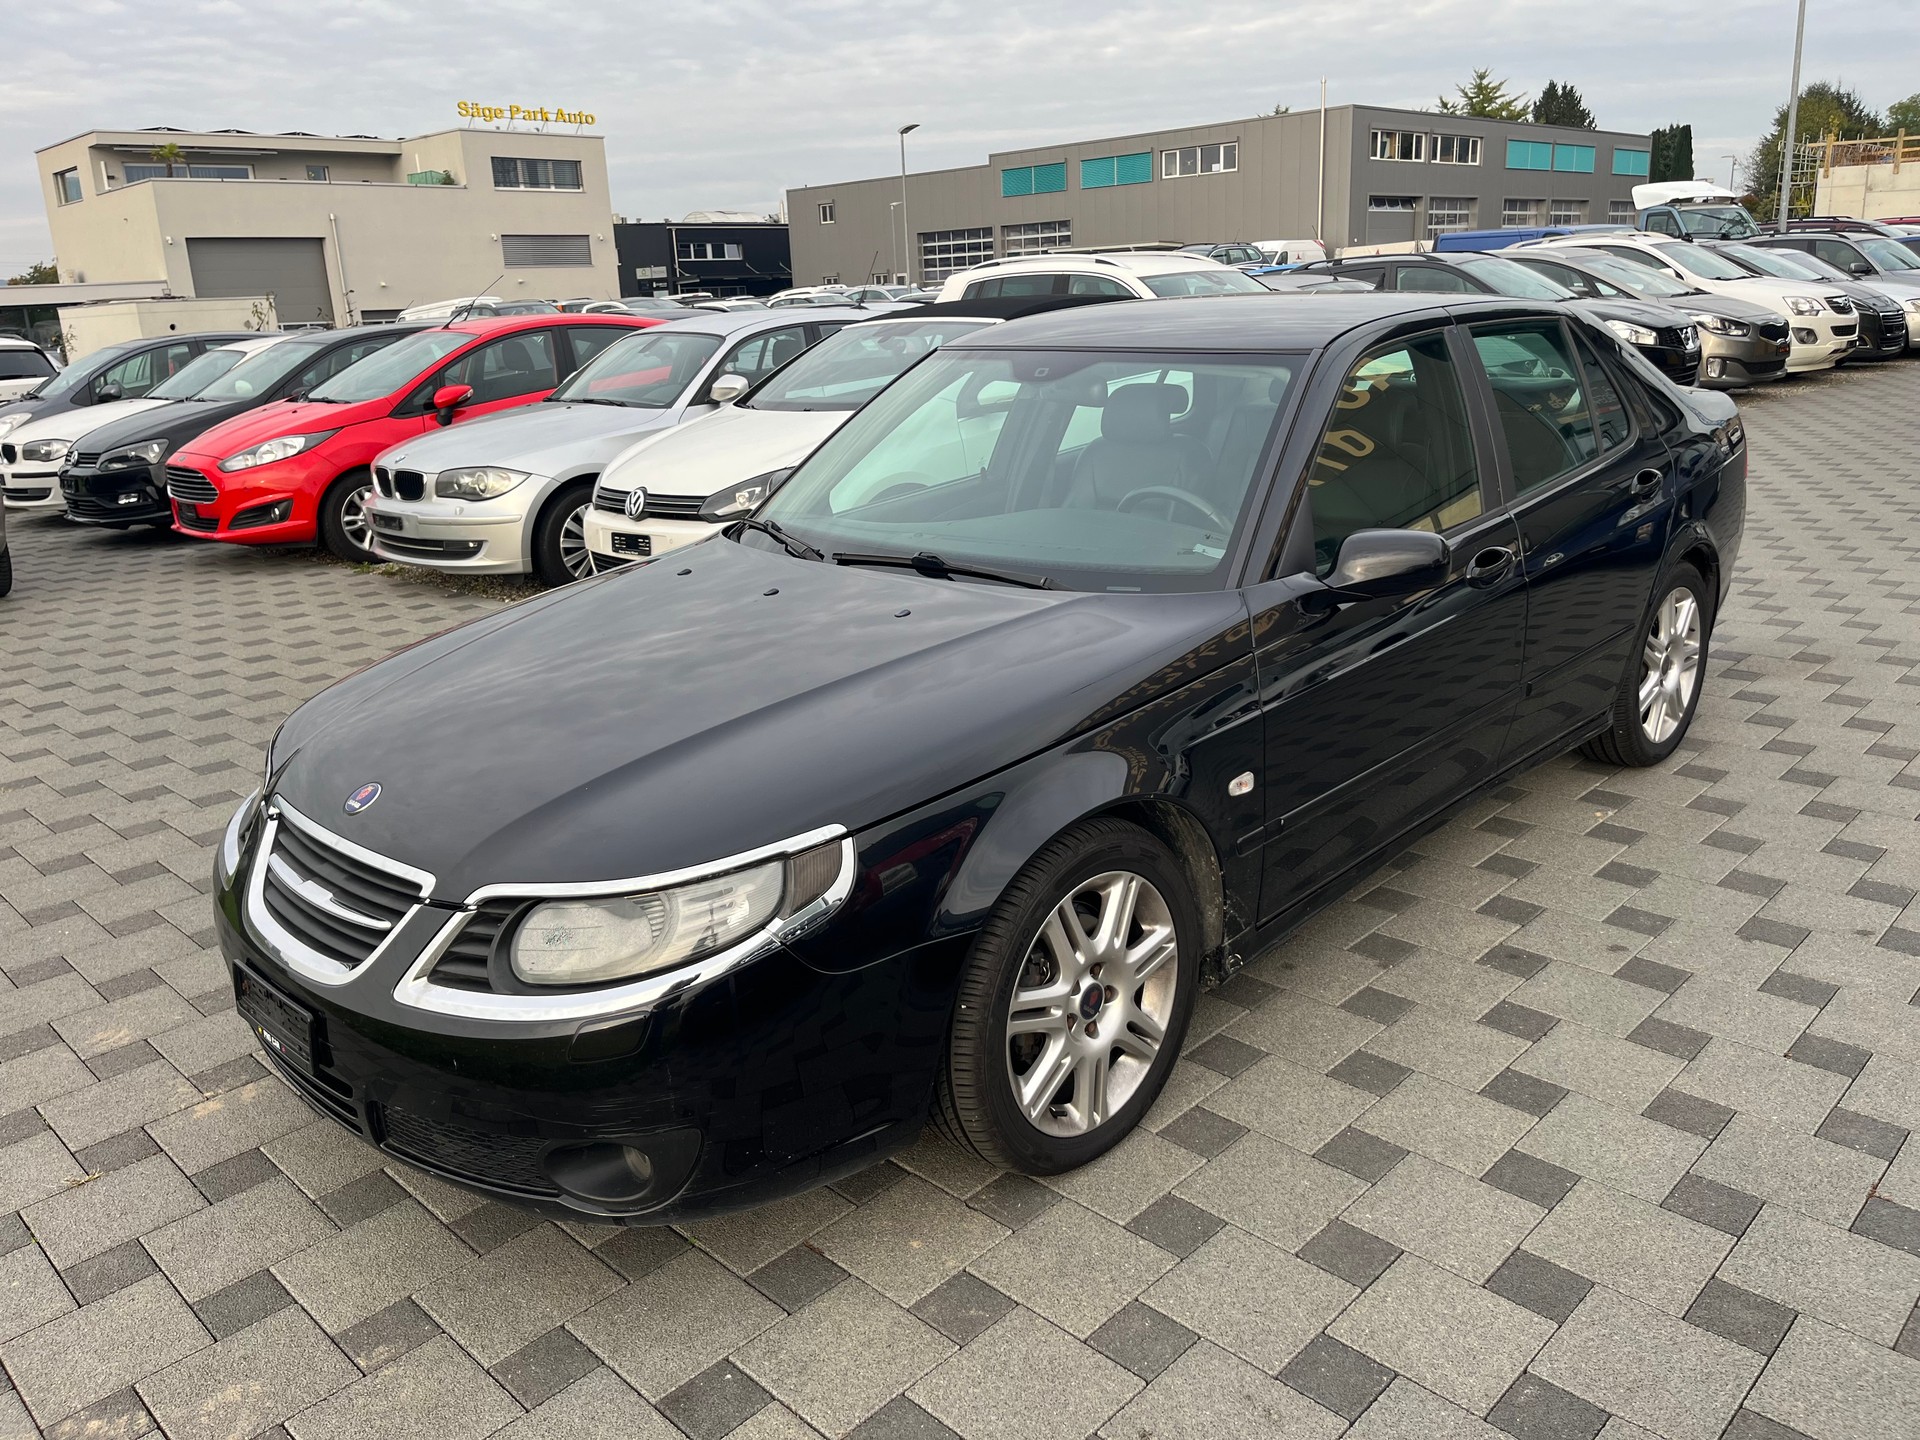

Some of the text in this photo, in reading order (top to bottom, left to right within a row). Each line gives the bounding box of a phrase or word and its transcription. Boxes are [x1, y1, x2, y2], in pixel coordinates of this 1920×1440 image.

[457, 101, 596, 125] Säge Park Auto
